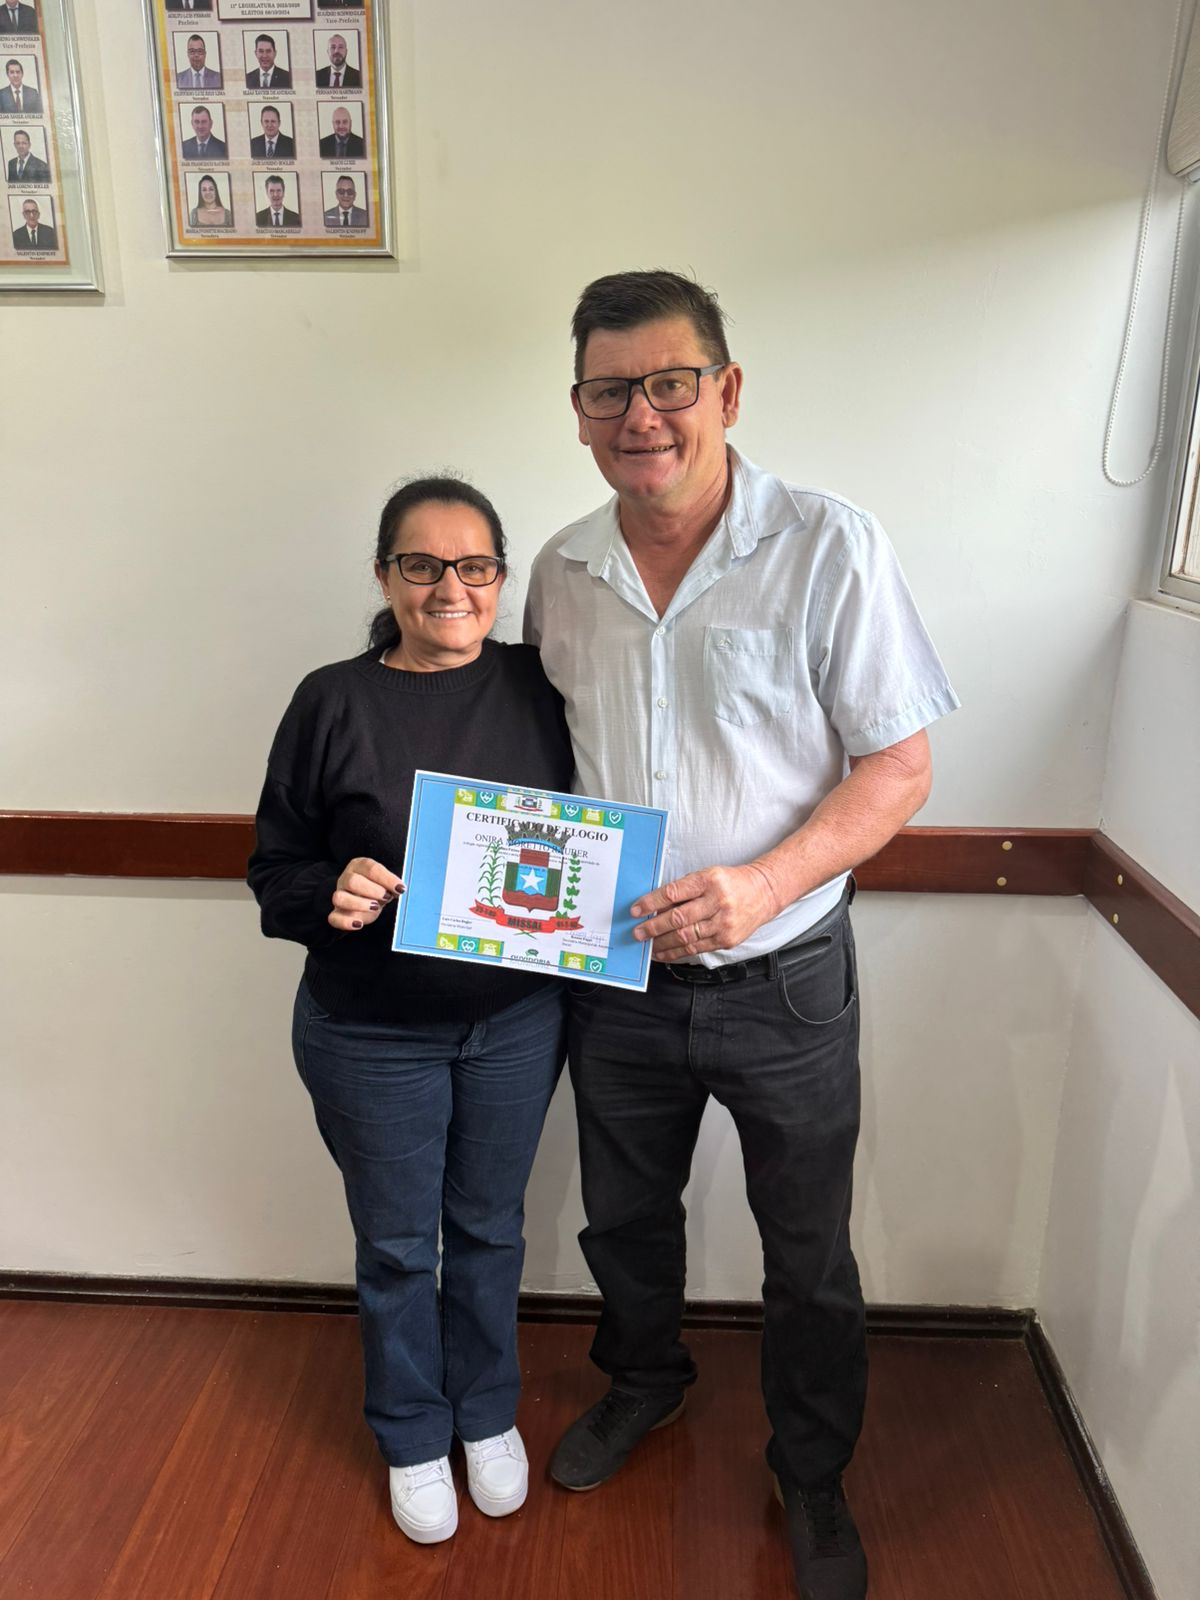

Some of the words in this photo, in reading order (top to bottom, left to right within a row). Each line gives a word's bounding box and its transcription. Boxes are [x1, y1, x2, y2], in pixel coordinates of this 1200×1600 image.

[475, 833, 504, 845] ONIRA
[546, 824, 561, 836] DE
[564, 827, 609, 843] ELOGIO
[507, 917, 542, 931] MISSAL
